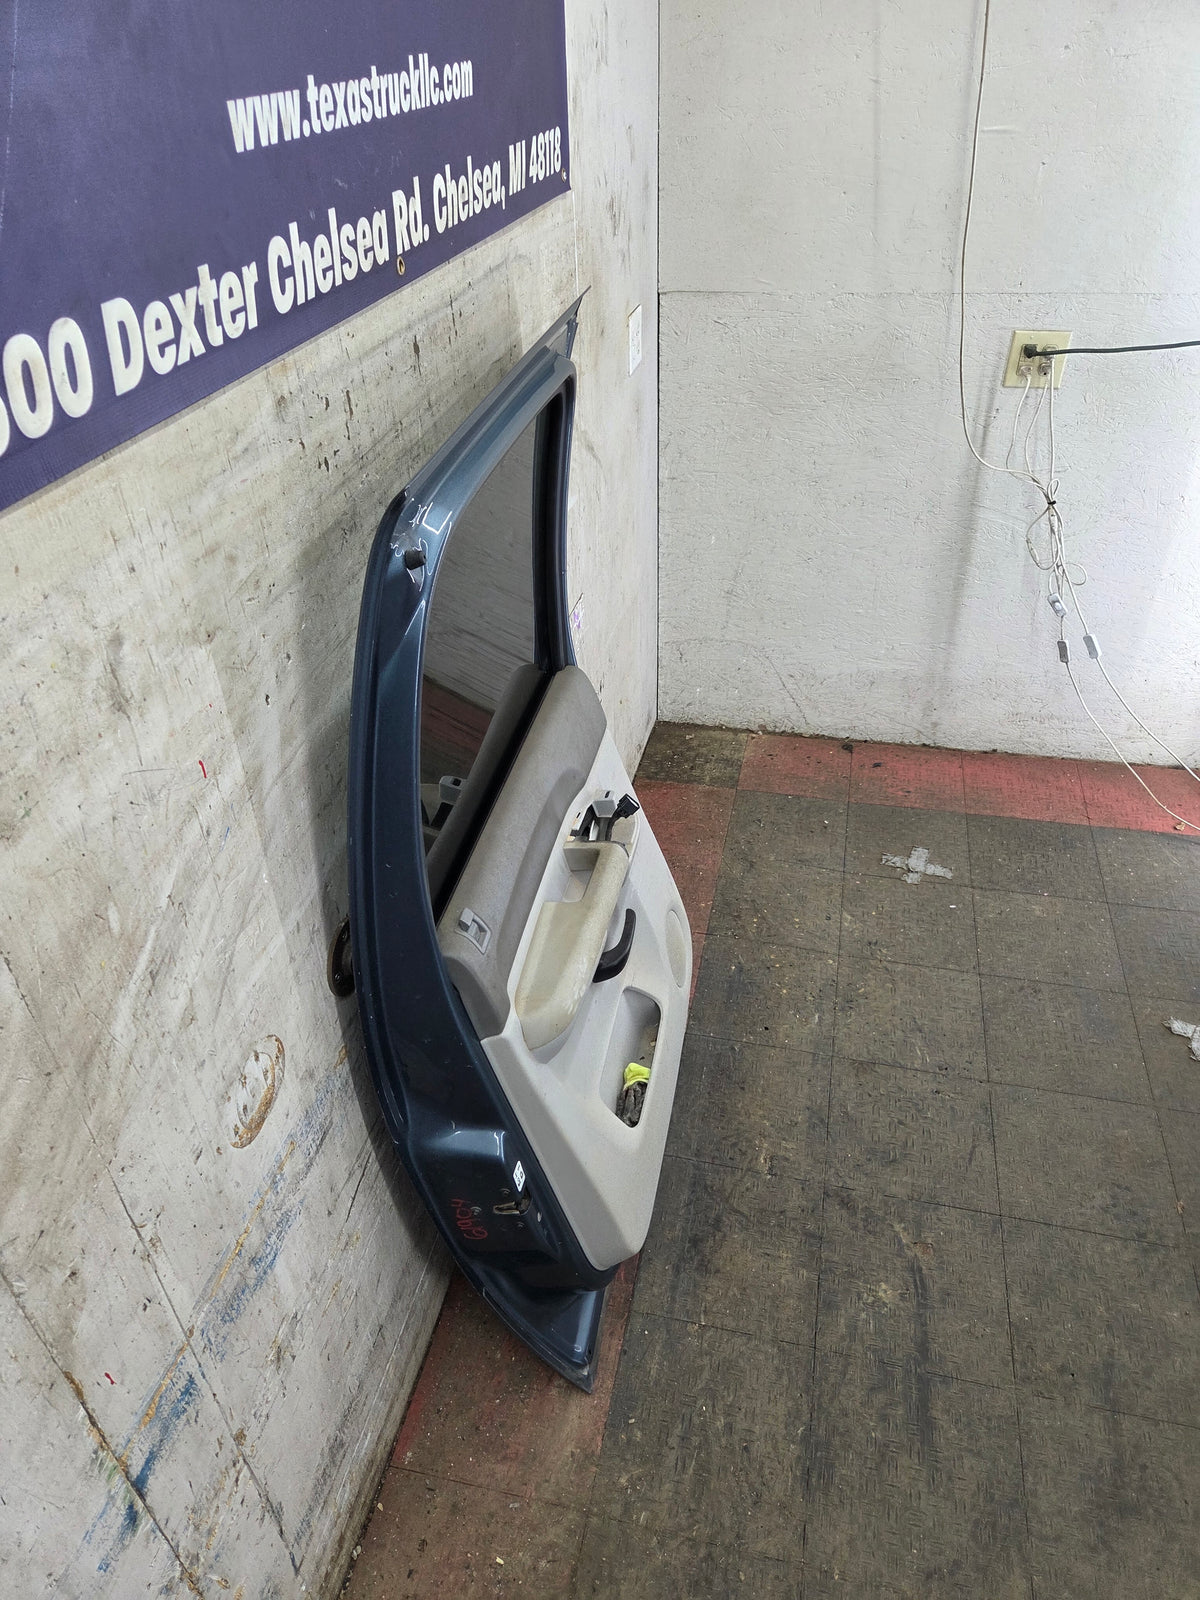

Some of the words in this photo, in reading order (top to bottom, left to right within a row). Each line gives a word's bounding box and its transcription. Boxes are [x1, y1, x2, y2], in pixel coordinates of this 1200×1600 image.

[227, 53, 474, 154] www.texastruckllc.com
[0, 317, 94, 457] 00
[101, 261, 259, 397] Dexter
[268, 207, 390, 315] Chelsea
[392, 176, 430, 256] Rd.
[433, 155, 506, 234] Chelsea,
[508, 140, 526, 197] MI
[528, 126, 562, 184] 48118
